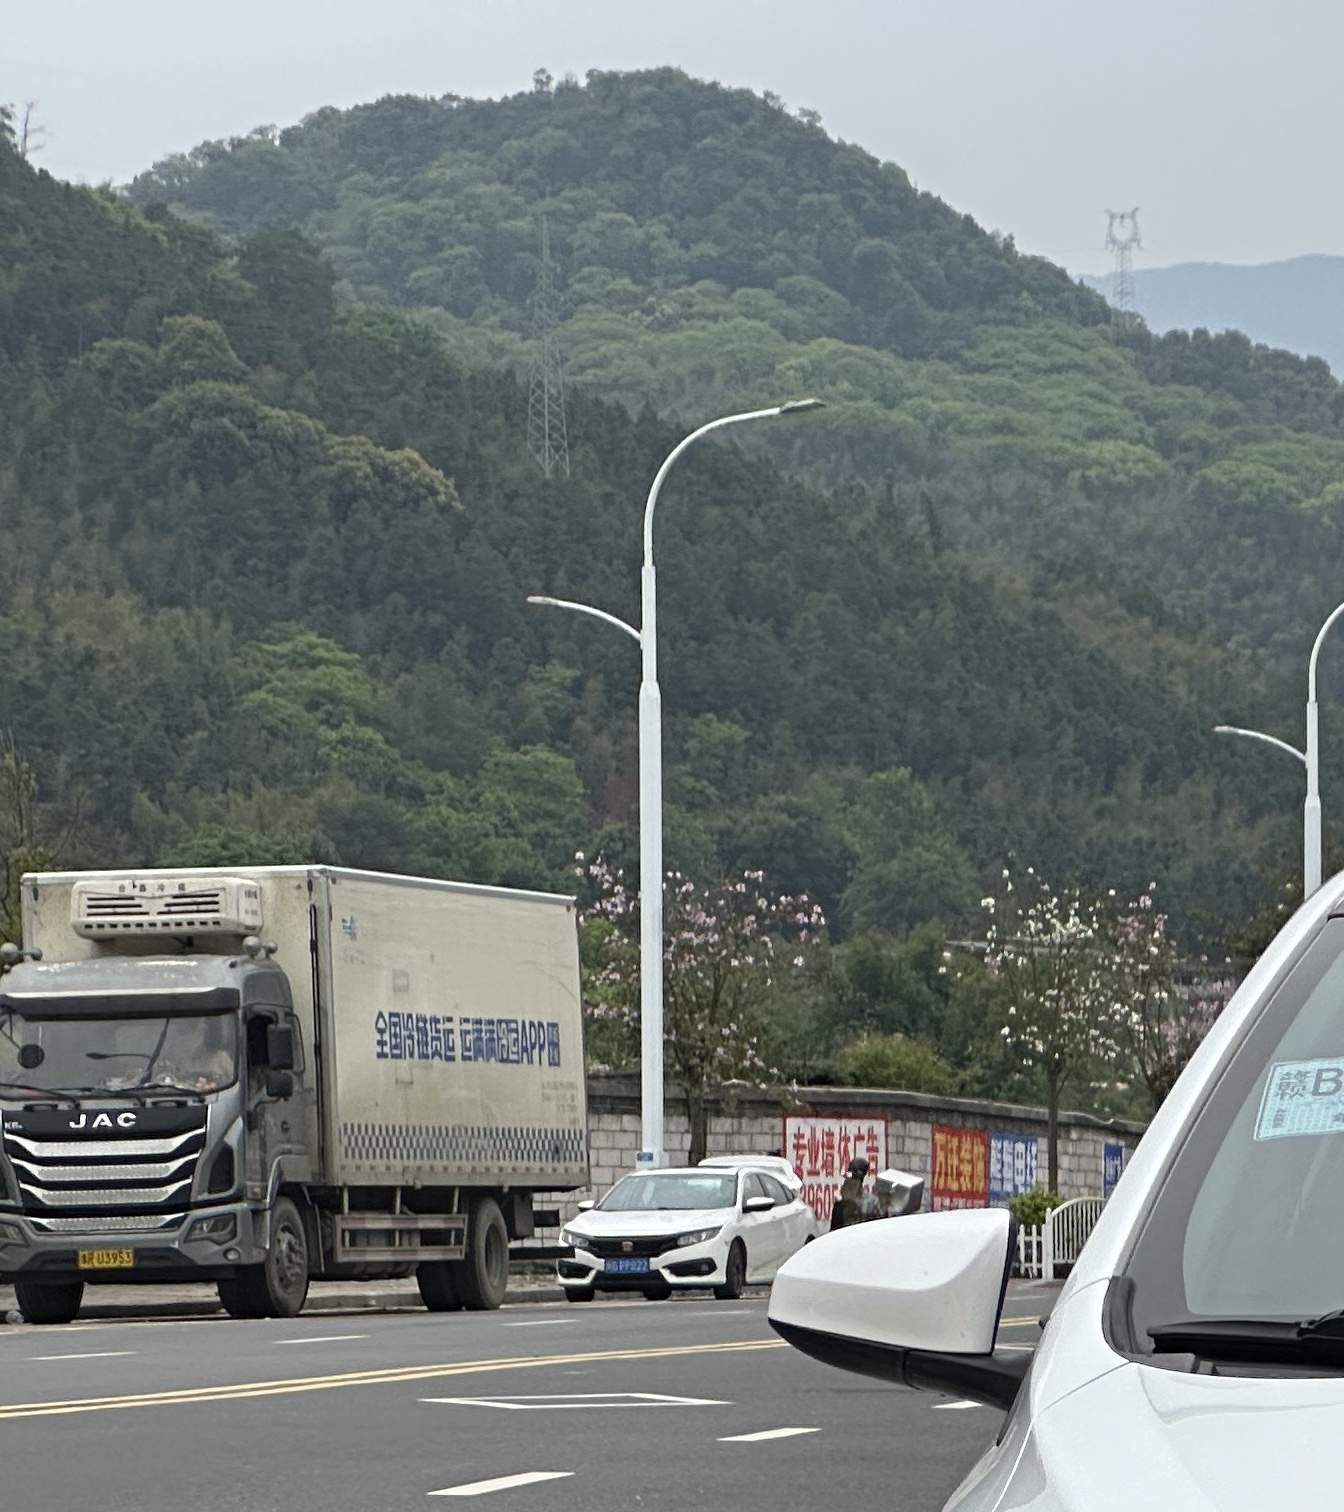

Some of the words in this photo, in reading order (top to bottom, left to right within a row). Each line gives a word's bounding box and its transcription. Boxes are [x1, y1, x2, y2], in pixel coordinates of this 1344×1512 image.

[374, 1010, 456, 1062] 全国冷链货运
[69, 1112, 137, 1129] JAC
[792, 1125, 880, 1178] 专业墙体广告
